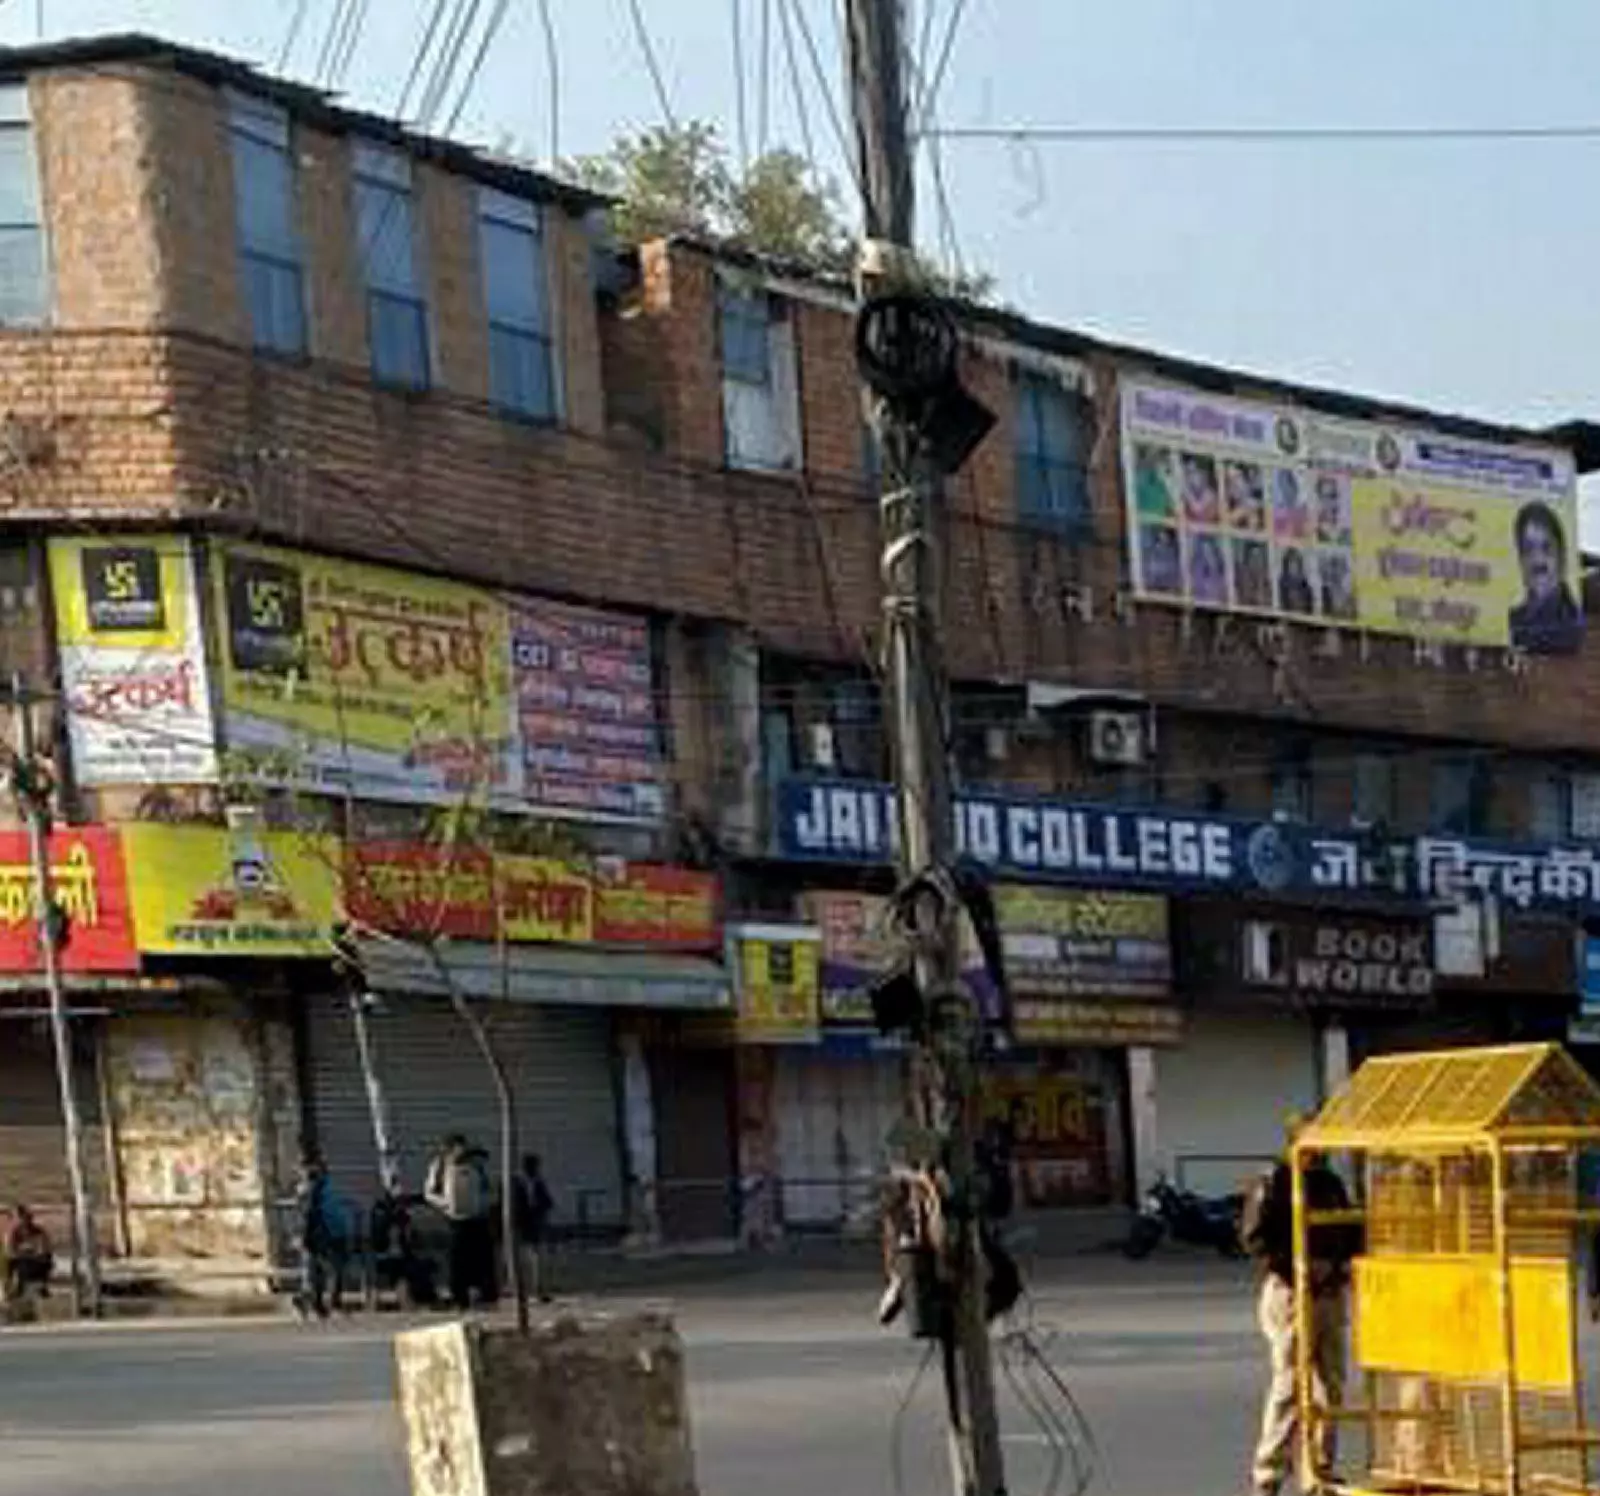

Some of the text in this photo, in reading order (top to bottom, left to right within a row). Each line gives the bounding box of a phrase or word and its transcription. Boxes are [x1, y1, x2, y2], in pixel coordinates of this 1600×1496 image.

[795, 789, 882, 853] JAI
[1006, 799, 1234, 880] COLLEGE
[1313, 927, 1428, 964] BOOK
[1296, 959, 1434, 996] WORLD
